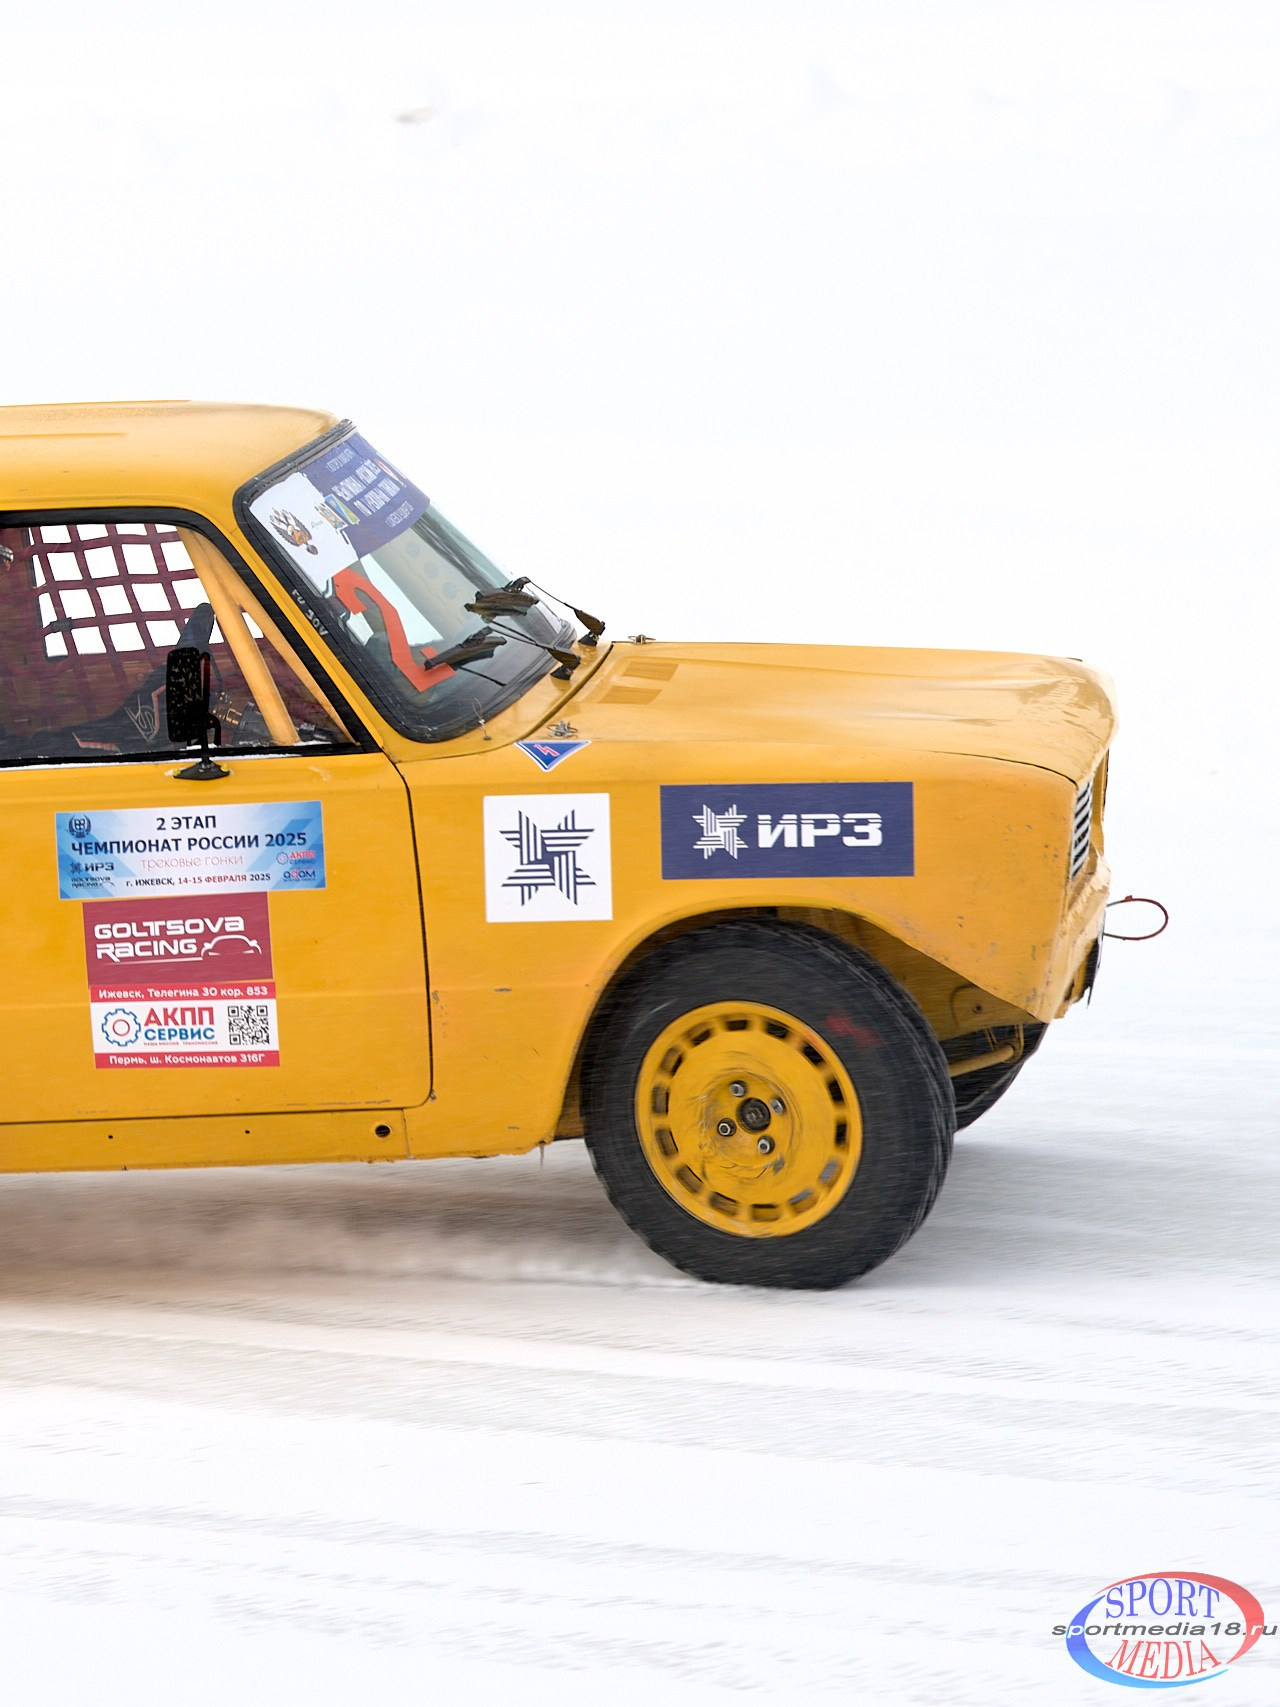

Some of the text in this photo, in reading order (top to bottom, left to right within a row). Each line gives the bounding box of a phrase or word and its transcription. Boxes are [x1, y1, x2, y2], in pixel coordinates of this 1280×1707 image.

[332, 567, 458, 693] 2
[156, 815, 217, 831] 2 ЭТАП
[757, 812, 883, 848] ИРЗ
[71, 832, 307, 856] ЧЕМПИОНАТ РОССИИ 2025
[205, 855, 243, 867] гонки
[135, 877, 175, 886] ИЖЕВСК,
[205, 875, 247, 883] ФЕВРАЛЯ
[249, 873, 271, 882] 2025
[94, 916, 245, 939] GOLTSOVA
[96, 938, 197, 962] RACING
[98, 988, 145, 999] Ижевск,
[147, 987, 199, 998] Телегина
[220, 987, 244, 998] кор.
[246, 986, 268, 996] 853
[143, 1006, 215, 1027] АКПП
[144, 1027, 215, 1041] СЕРВИС
[109, 1053, 265, 1065] Пермь, ш. Космонавтов 316Г
